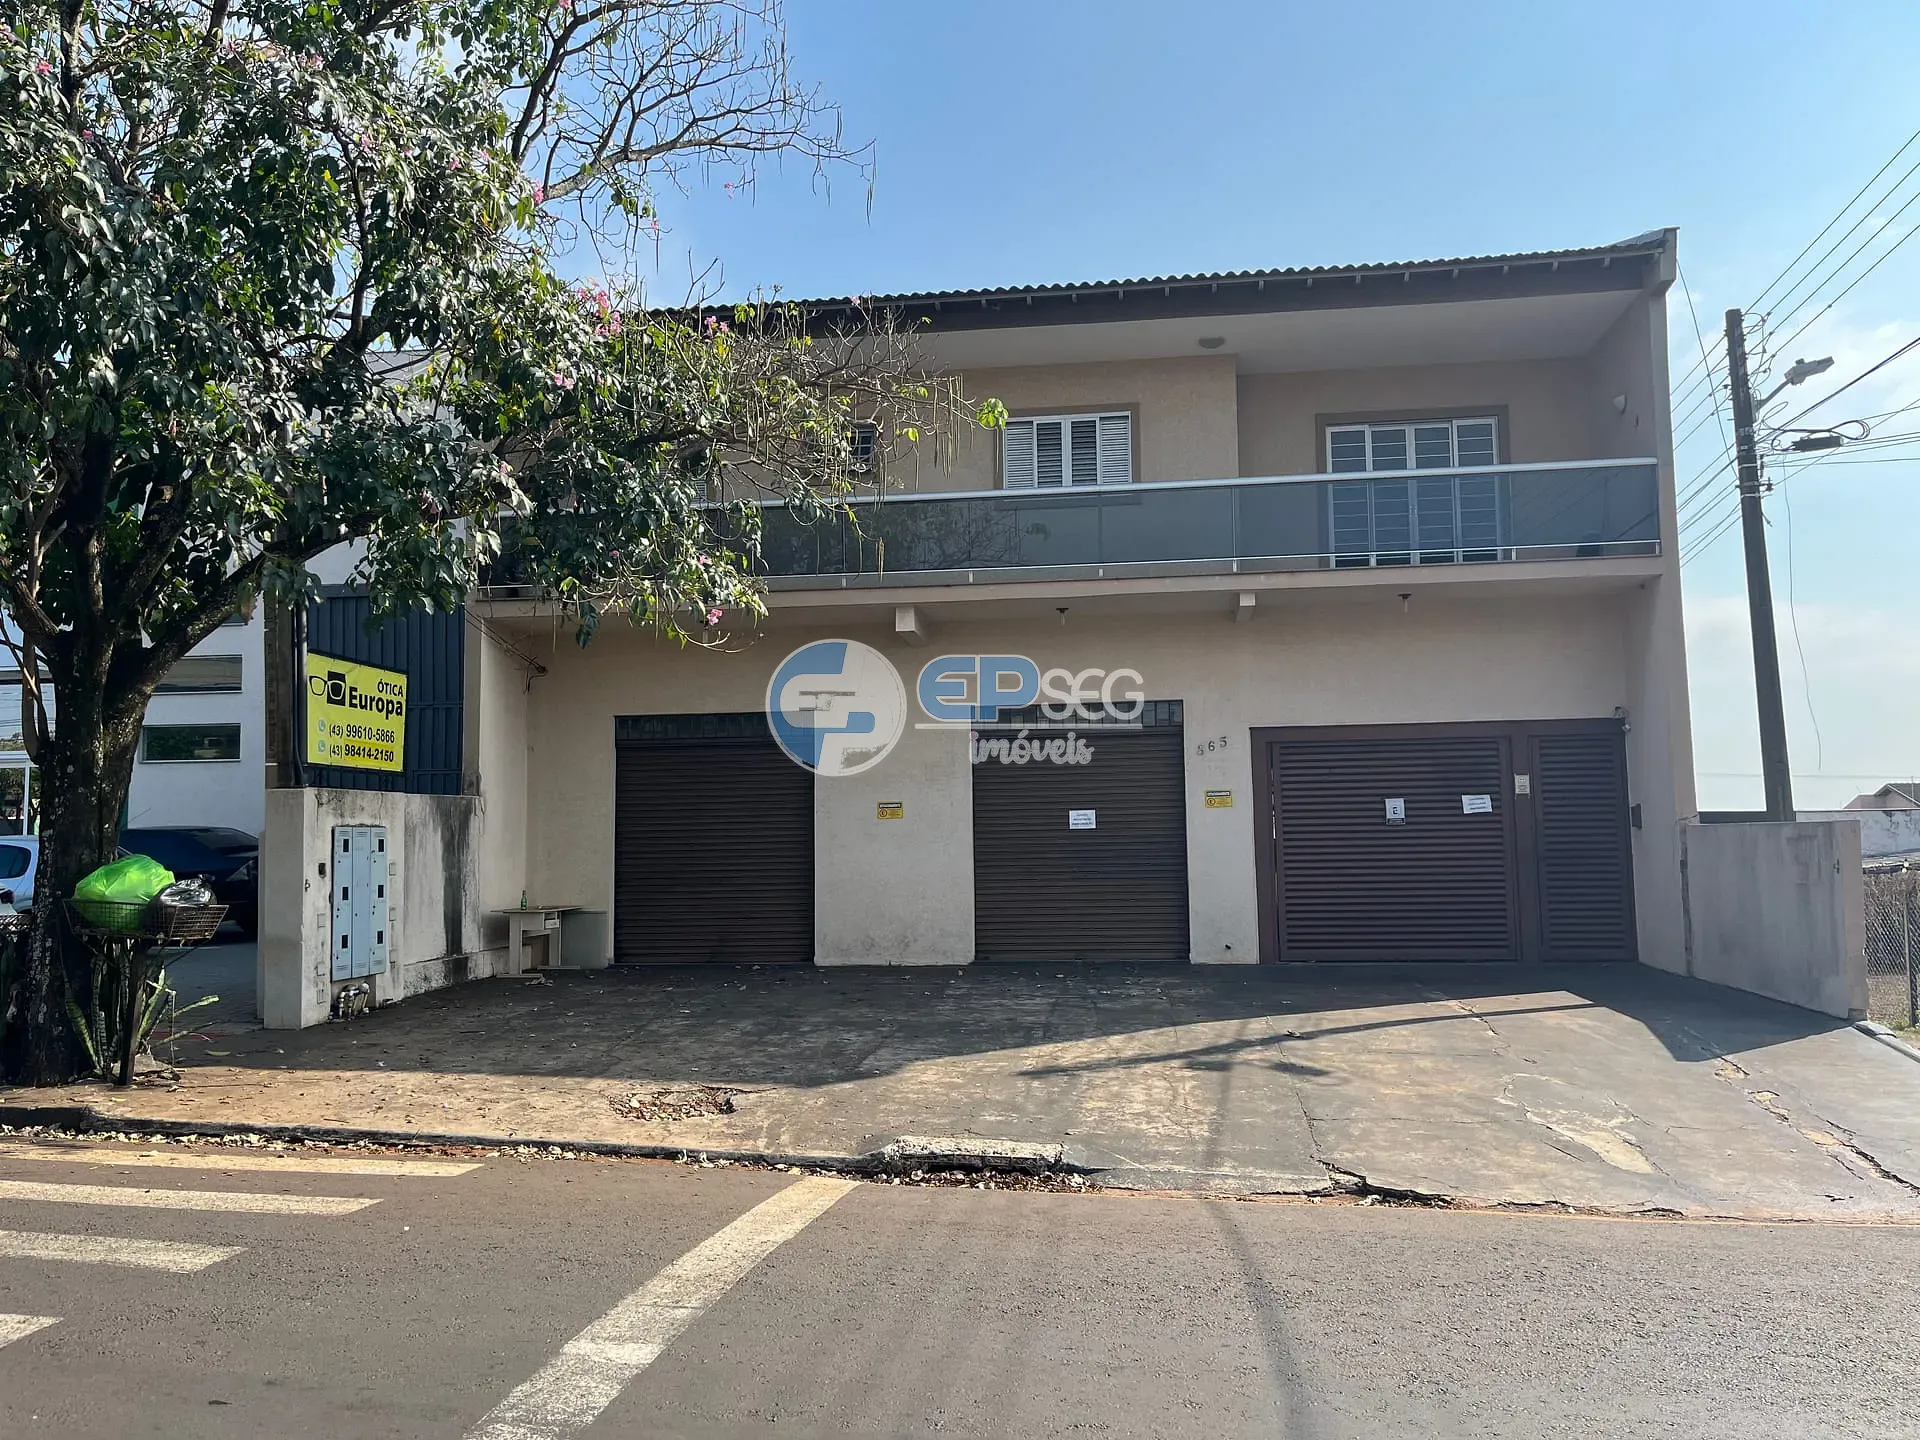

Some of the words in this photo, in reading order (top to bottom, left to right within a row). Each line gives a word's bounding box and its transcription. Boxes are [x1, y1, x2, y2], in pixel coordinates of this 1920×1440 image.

[377, 678, 404, 698] ÓTICA
[348, 686, 403, 720] Europa
[329, 723, 344, 738] (43)
[346, 723, 395, 744] 99610-5866
[329, 743, 343, 759] (43)
[344, 743, 395, 763] 98414-2150
